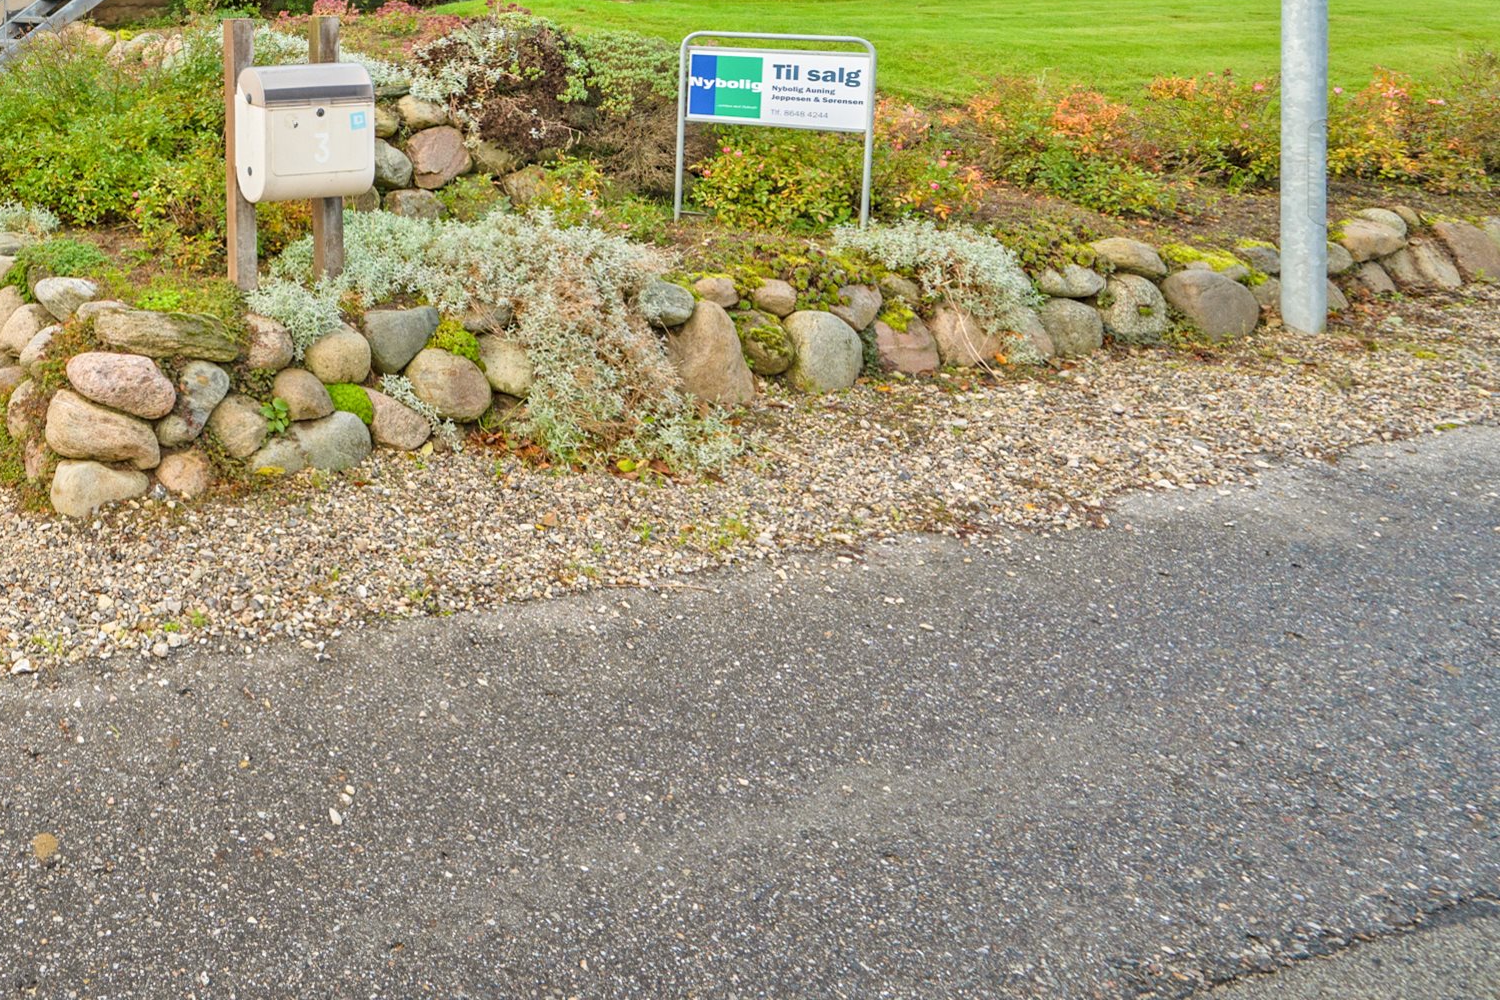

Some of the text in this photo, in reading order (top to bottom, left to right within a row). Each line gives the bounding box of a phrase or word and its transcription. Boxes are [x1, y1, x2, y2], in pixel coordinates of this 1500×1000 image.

[772, 63, 862, 87] Til salg
[690, 76, 763, 93] Nybolig
[772, 85, 836, 96] Nybolig Auning
[771, 94, 811, 103] Jeppesen
[822, 97, 864, 105] Sørensen
[313, 132, 330, 164] 3
